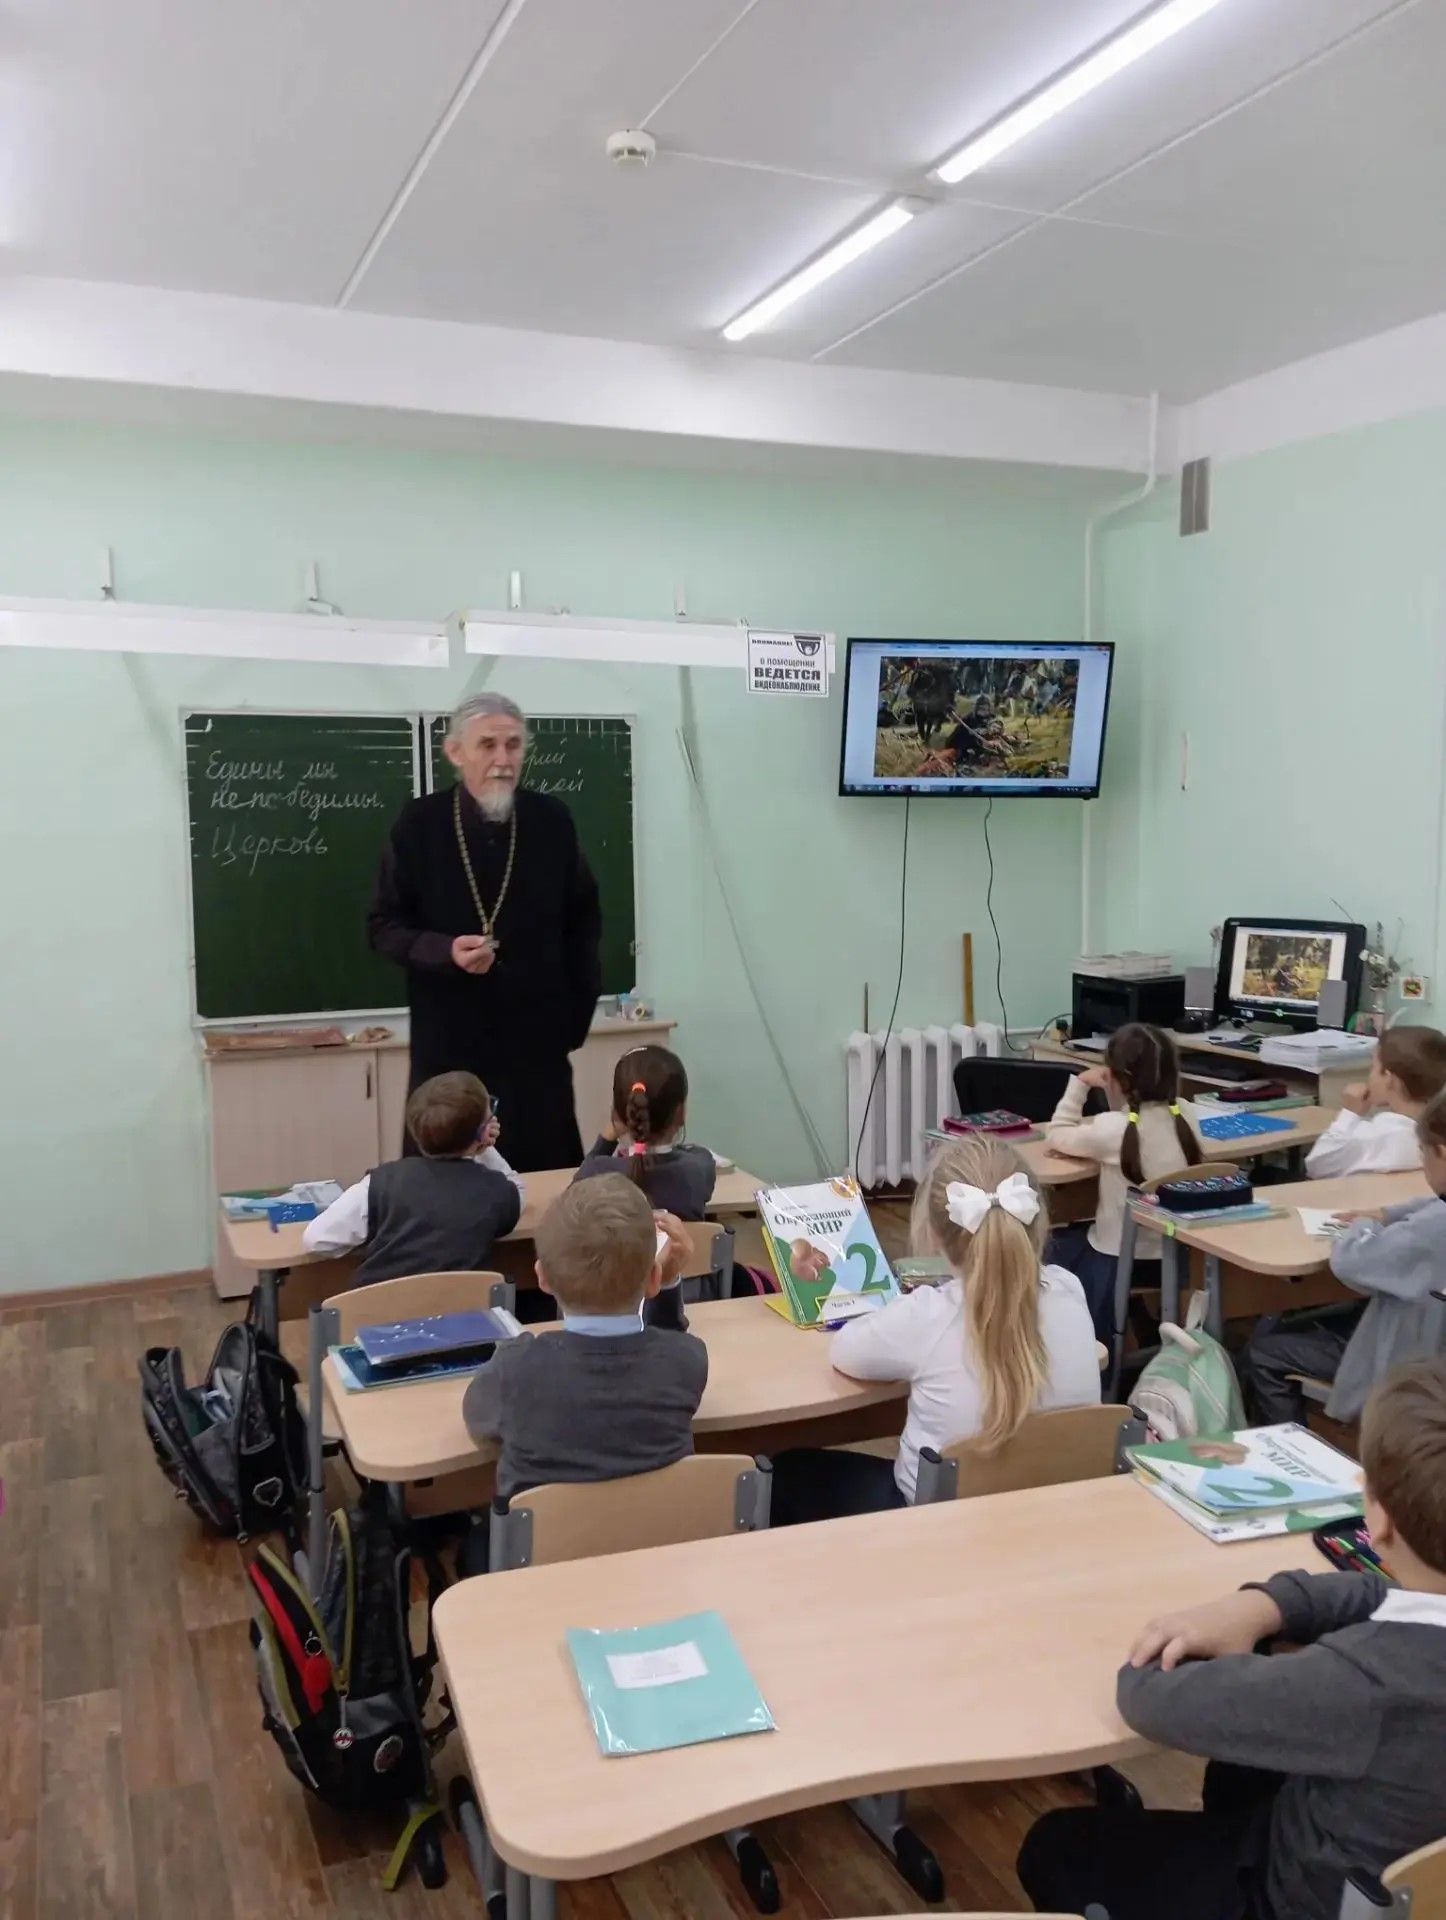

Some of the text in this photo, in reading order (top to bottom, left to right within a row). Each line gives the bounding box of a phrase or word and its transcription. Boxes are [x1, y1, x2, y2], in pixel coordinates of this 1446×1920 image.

[754, 667, 820, 680] ВЕДЕТСЯ
[767, 658, 815, 667] ПОМЕЩЕНИИ
[754, 680, 820, 692] ВИДЕОНАБЛЮДЕНИЕ
[205, 750, 339, 793] Едины мы
[211, 822, 329, 877] Церковь
[846, 1243, 891, 1292] 2
